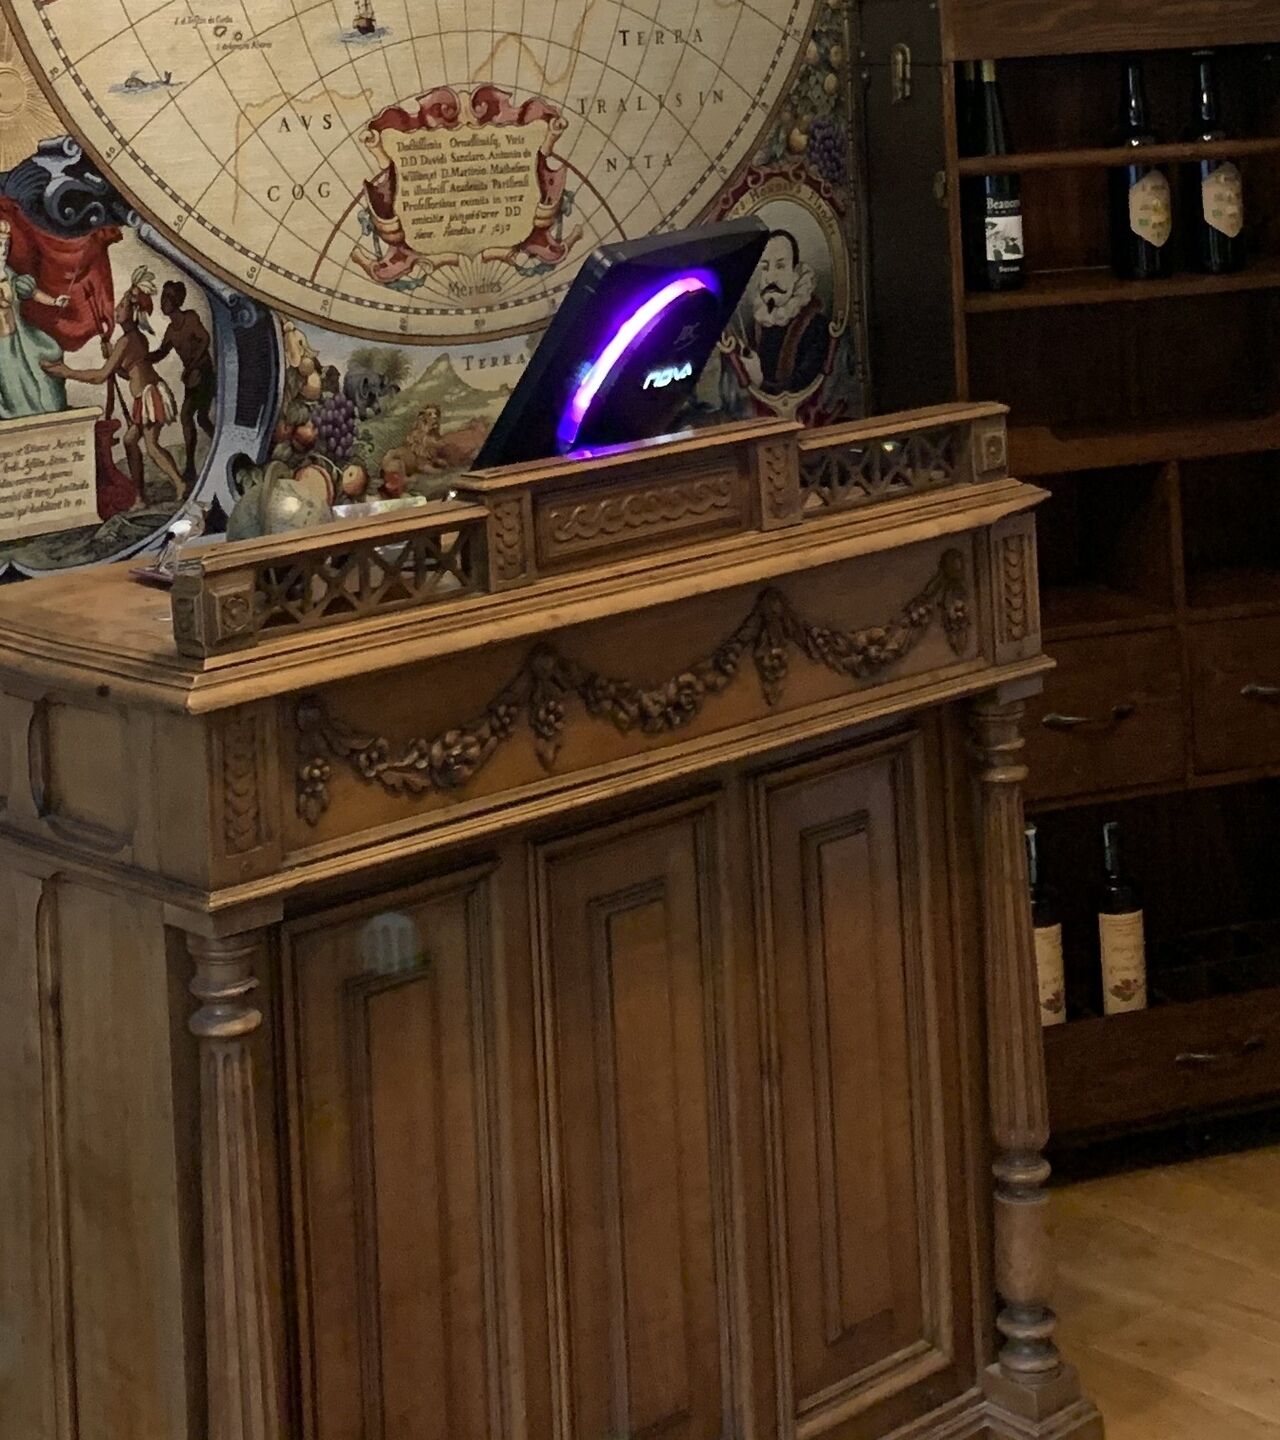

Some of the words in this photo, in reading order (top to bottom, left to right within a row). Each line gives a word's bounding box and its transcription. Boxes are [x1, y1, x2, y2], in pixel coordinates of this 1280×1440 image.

[278, 114, 332, 134] AVS
[267, 181, 331, 203] COG
[461, 352, 526, 372] TERRA
